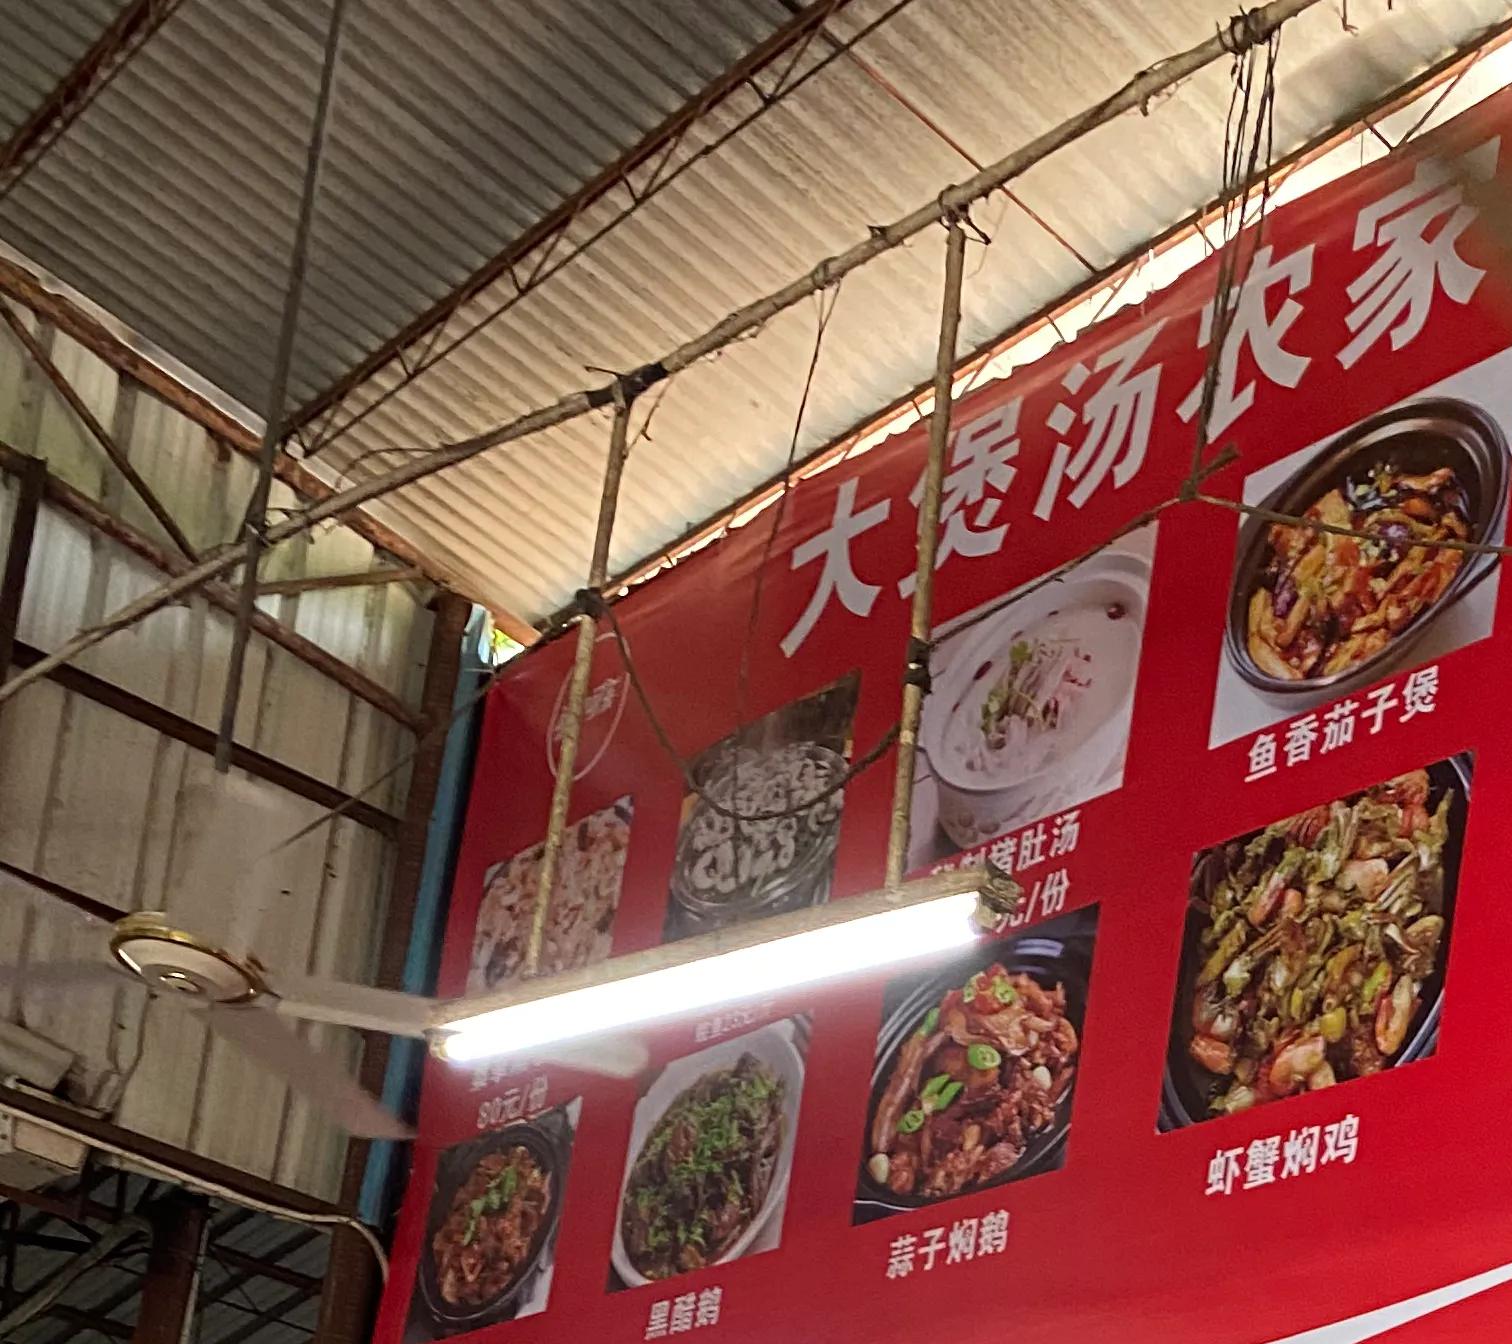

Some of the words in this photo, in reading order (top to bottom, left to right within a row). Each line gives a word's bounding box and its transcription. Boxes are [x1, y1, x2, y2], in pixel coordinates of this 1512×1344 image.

[1244, 665, 1439, 782] 鱼香茄子煲
[1205, 1114, 1359, 1196] 虾蟹焖鸡
[886, 1209, 1010, 1280] 蒜子焖鹅
